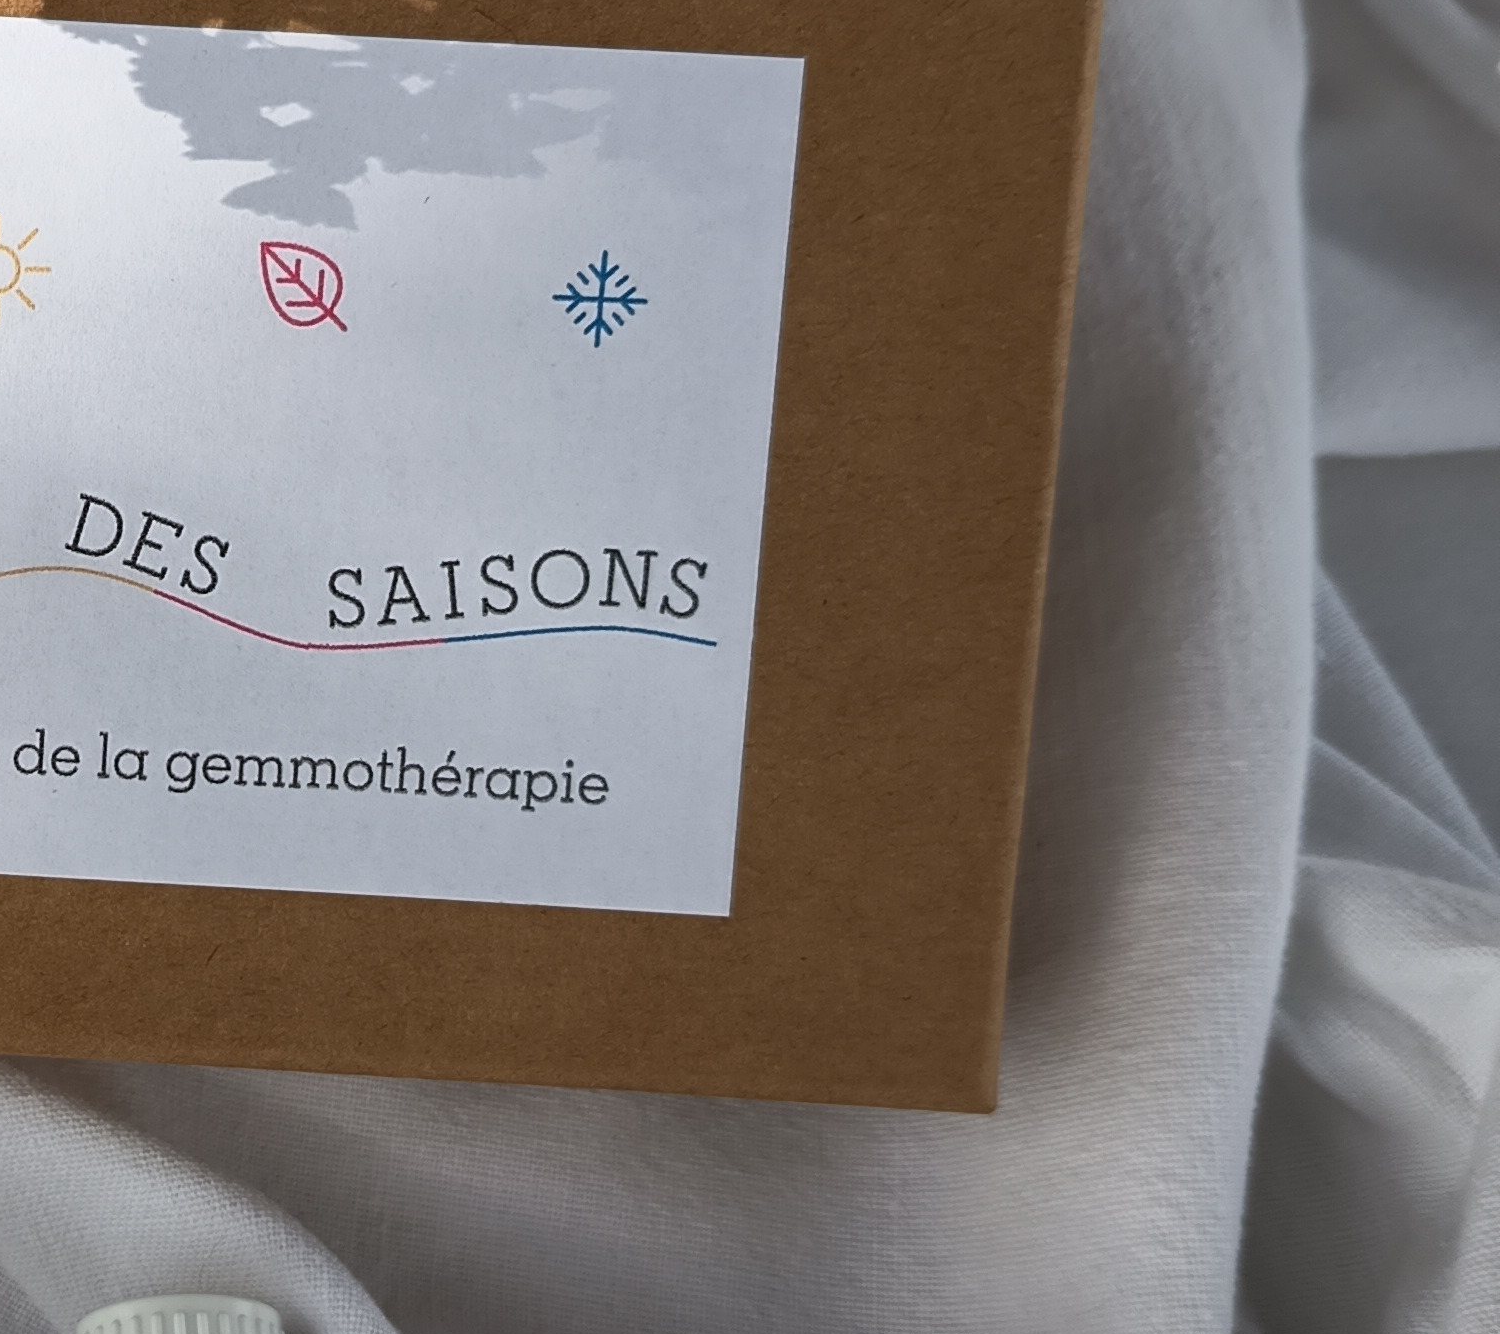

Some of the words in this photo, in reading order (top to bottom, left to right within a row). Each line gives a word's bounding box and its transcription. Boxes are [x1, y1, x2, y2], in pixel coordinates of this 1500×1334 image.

[64, 492, 231, 599] DES
[325, 545, 710, 632] SAISONS
[12, 727, 82, 782] de
[97, 729, 150, 785] la
[164, 741, 612, 814] gemmothérapie
